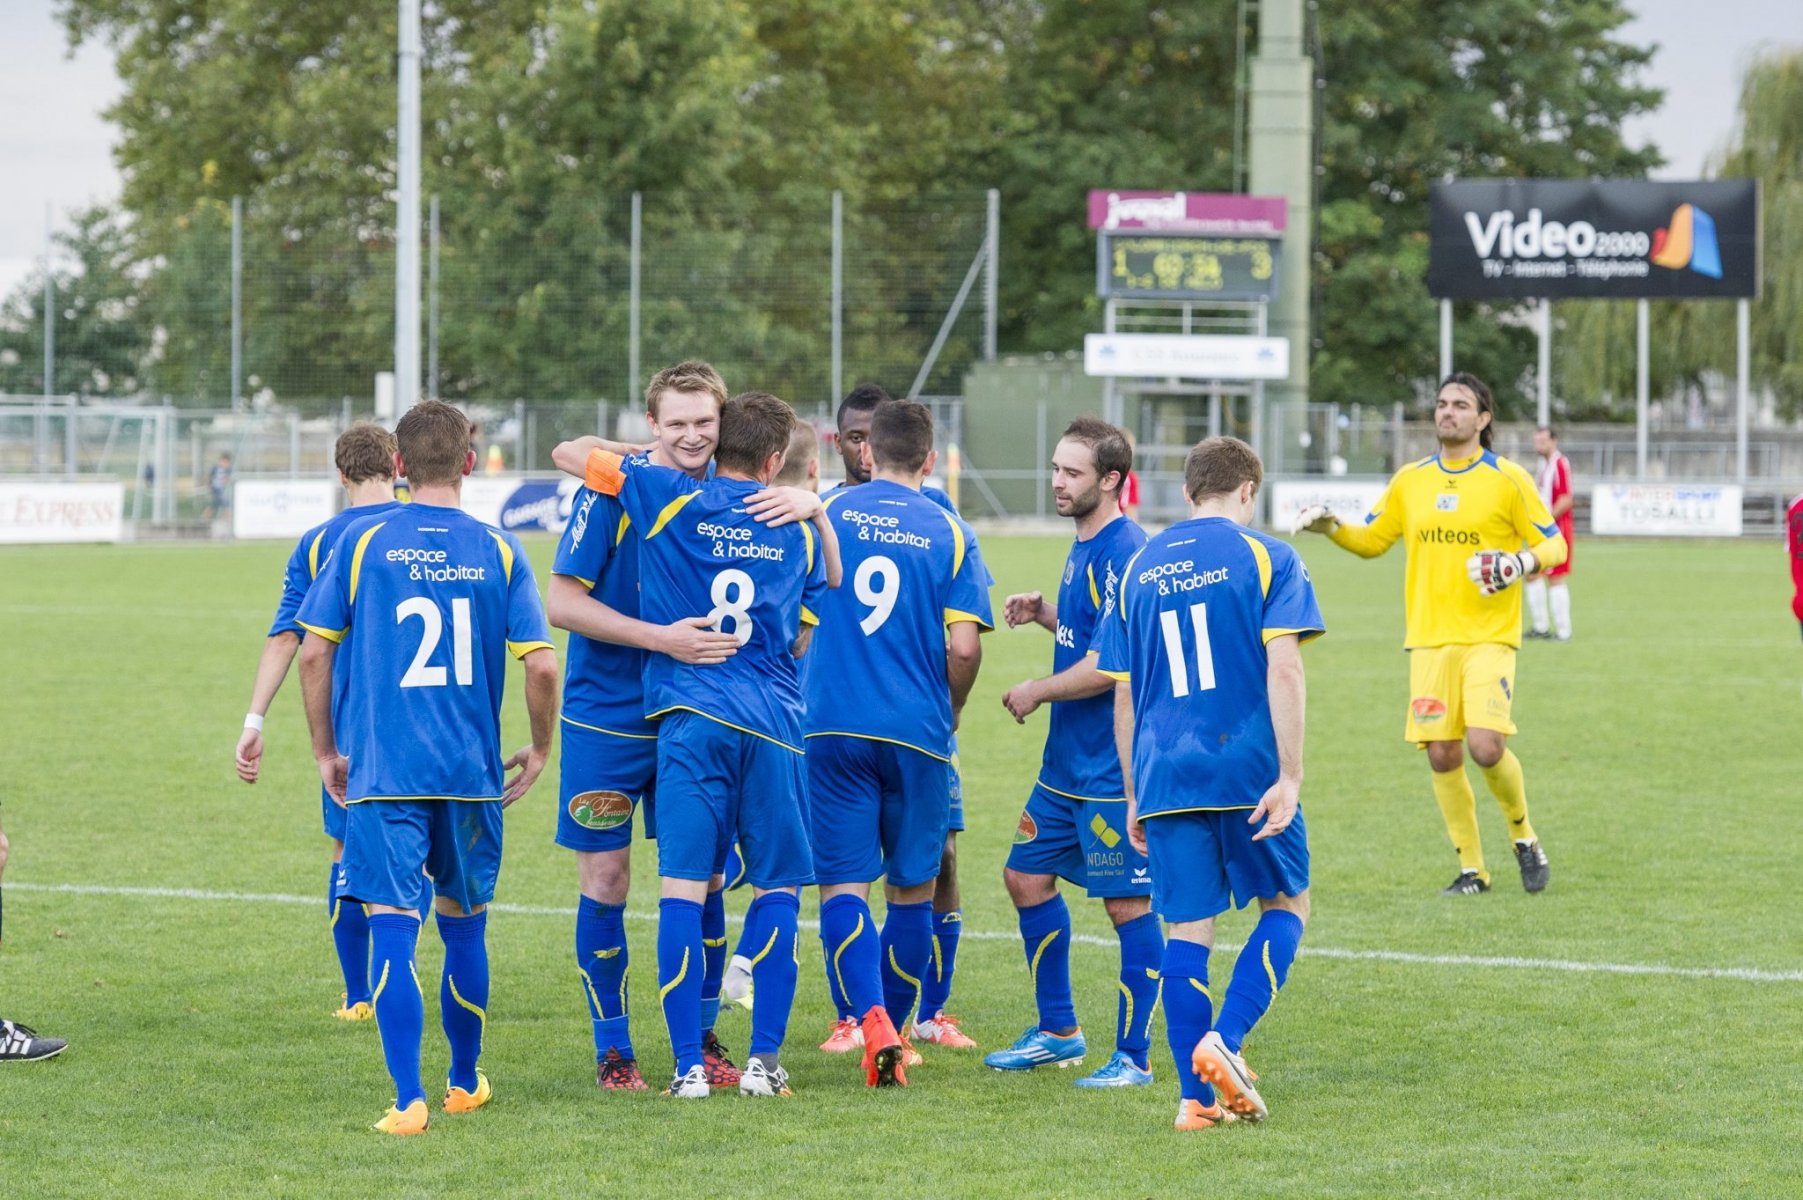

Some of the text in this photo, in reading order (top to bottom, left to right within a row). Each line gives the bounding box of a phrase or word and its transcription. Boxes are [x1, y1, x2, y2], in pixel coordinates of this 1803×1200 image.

[1481, 258, 1505, 278] TV
[1512, 259, 1567, 278] Internet
[842, 509, 900, 527] espace
[696, 522, 753, 541] espace
[858, 526, 932, 549] & habitat
[386, 549, 447, 565] espace
[712, 541, 784, 561] & habitat
[409, 564, 485, 581] & habitat
[1138, 560, 1194, 584] espace
[1158, 567, 1229, 596] & habitat
[854, 555, 900, 637] 9
[706, 568, 755, 646] 8
[396, 596, 472, 687] 21
[1160, 602, 1216, 698] 11
[1087, 852, 1124, 867] NDAGO
